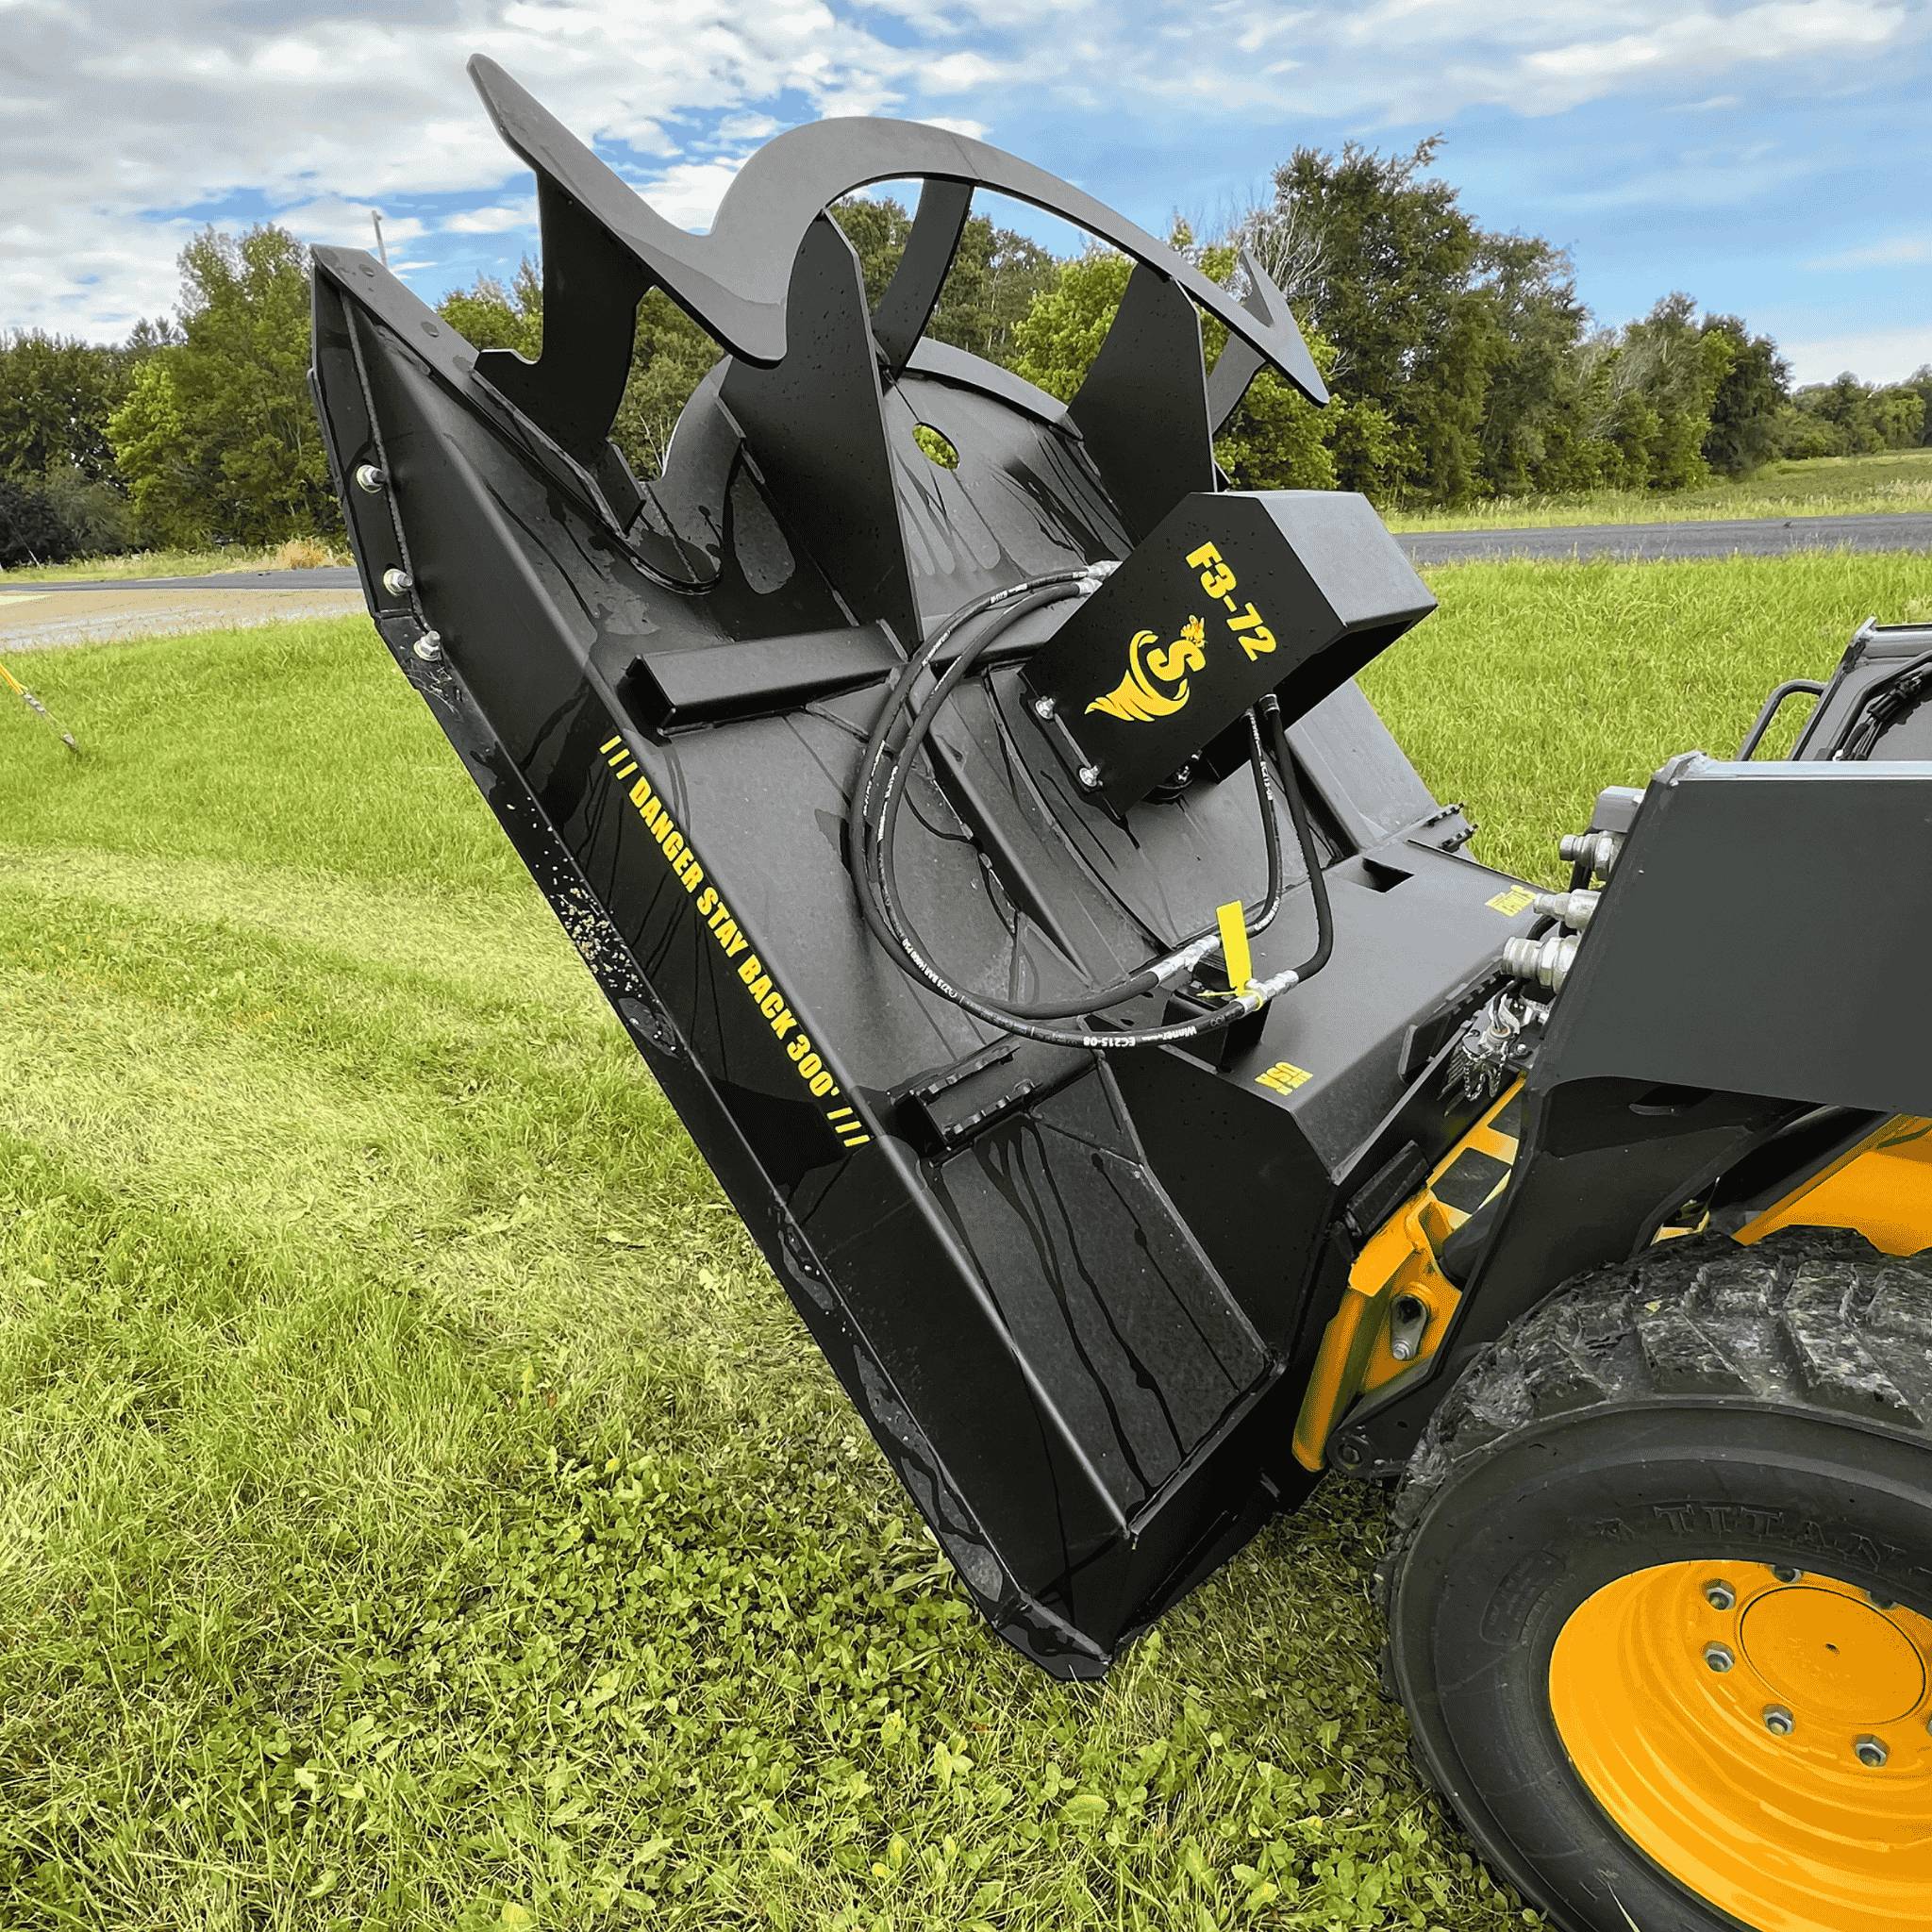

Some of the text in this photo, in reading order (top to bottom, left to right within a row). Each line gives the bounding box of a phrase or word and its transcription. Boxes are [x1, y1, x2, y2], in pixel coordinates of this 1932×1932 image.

[1185, 541, 1277, 662] F3-72
[629, 775, 841, 1098] DANGER STAY BACK 300'
[1082, 1036, 1136, 1047] EC215-08
